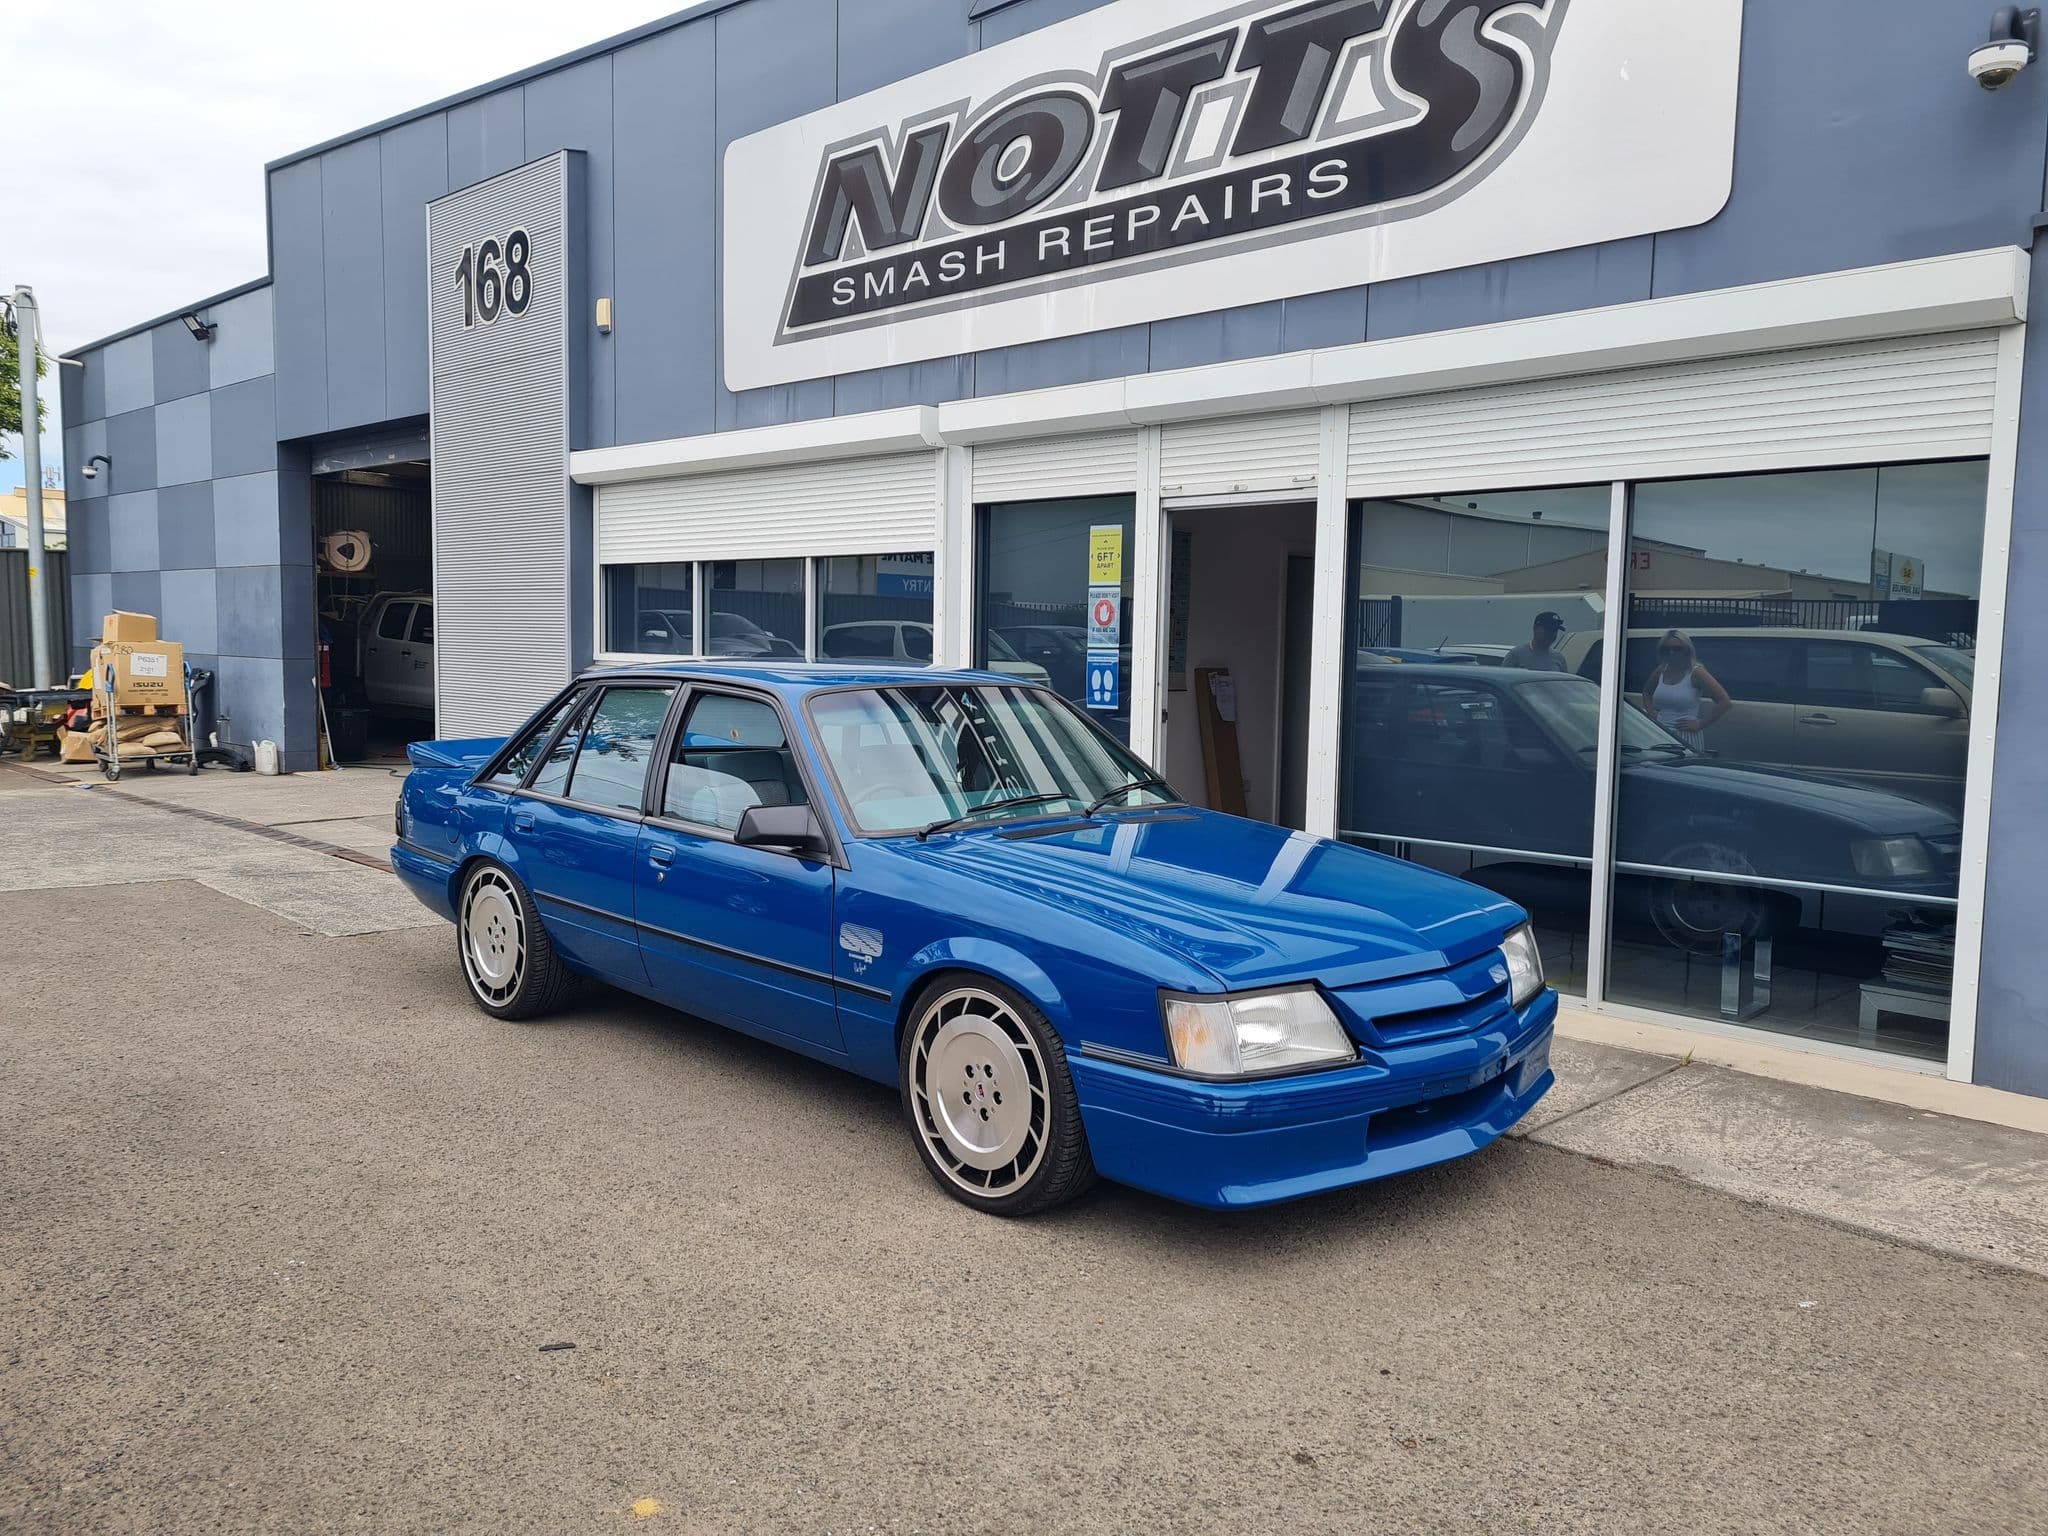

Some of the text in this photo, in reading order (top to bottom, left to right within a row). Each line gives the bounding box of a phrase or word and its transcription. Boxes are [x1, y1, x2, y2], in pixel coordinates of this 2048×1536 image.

[802, 0, 1545, 268] NOTTS
[454, 225, 533, 331] 168
[831, 157, 1351, 306] SMASH REPAIRS
[1096, 552, 1114, 562] 6FT
